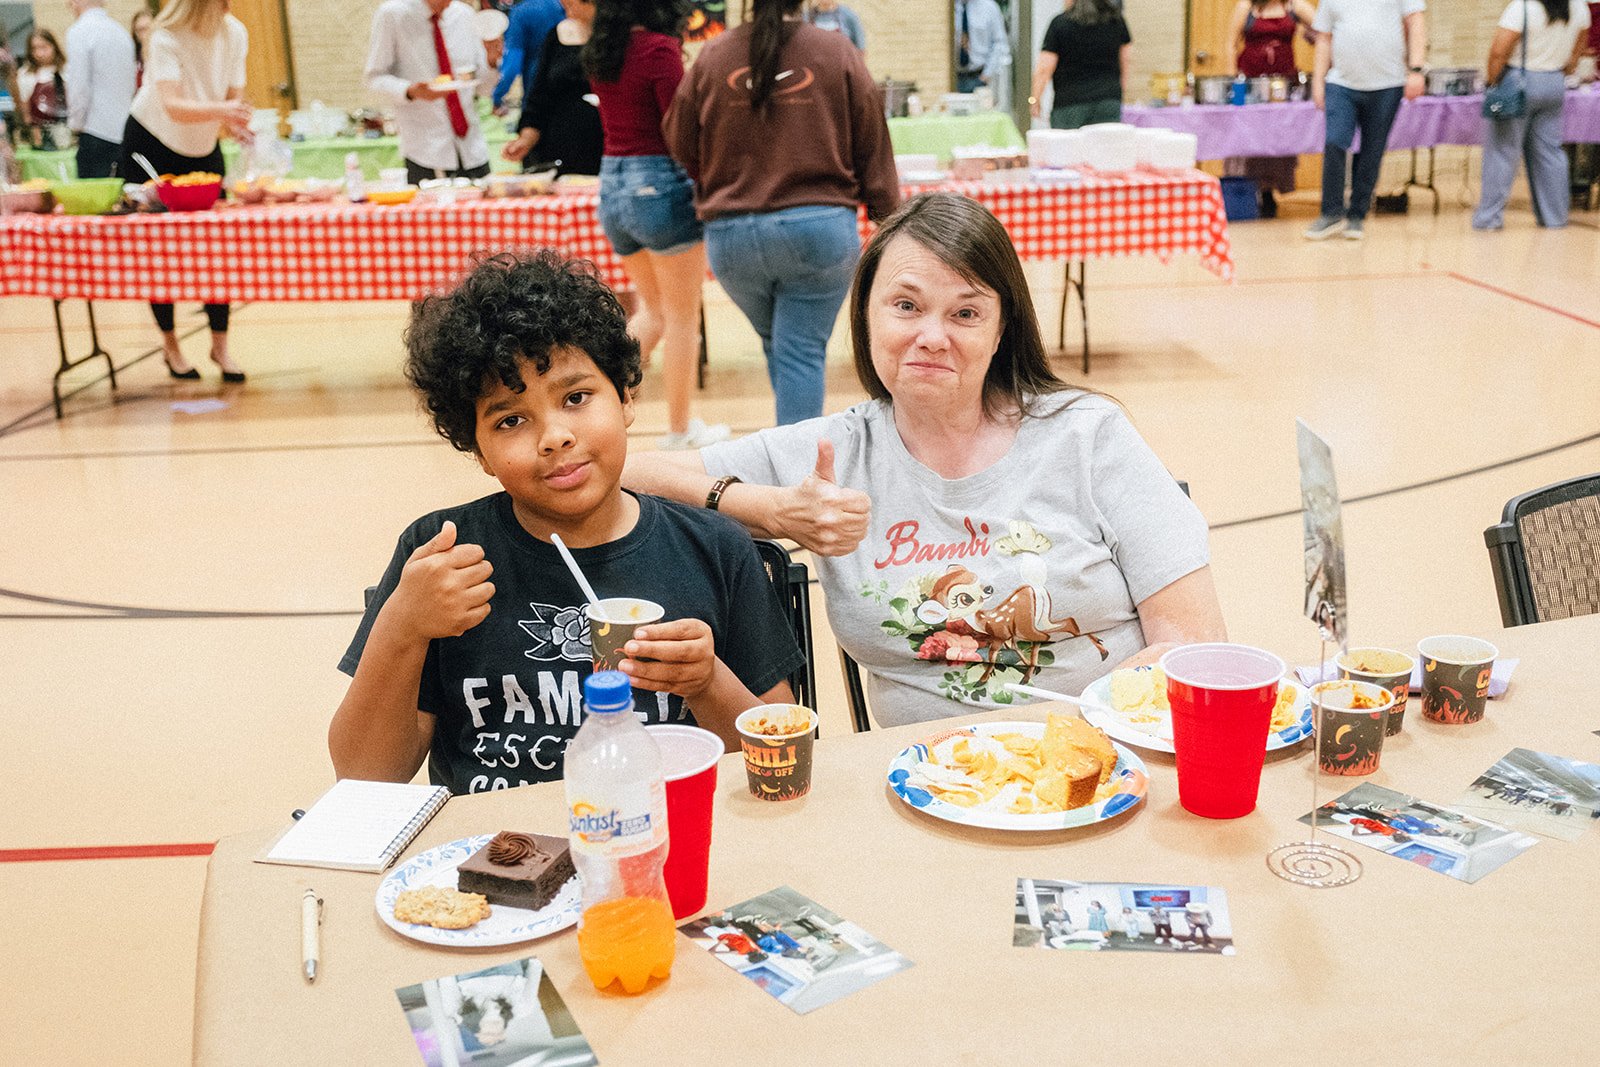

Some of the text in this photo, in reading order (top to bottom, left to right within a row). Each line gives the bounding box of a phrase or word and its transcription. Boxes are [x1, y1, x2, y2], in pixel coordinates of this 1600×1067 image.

[874, 516, 991, 569] Bambi
[472, 732, 574, 770] ESC
[774, 766, 795, 778] OFF
